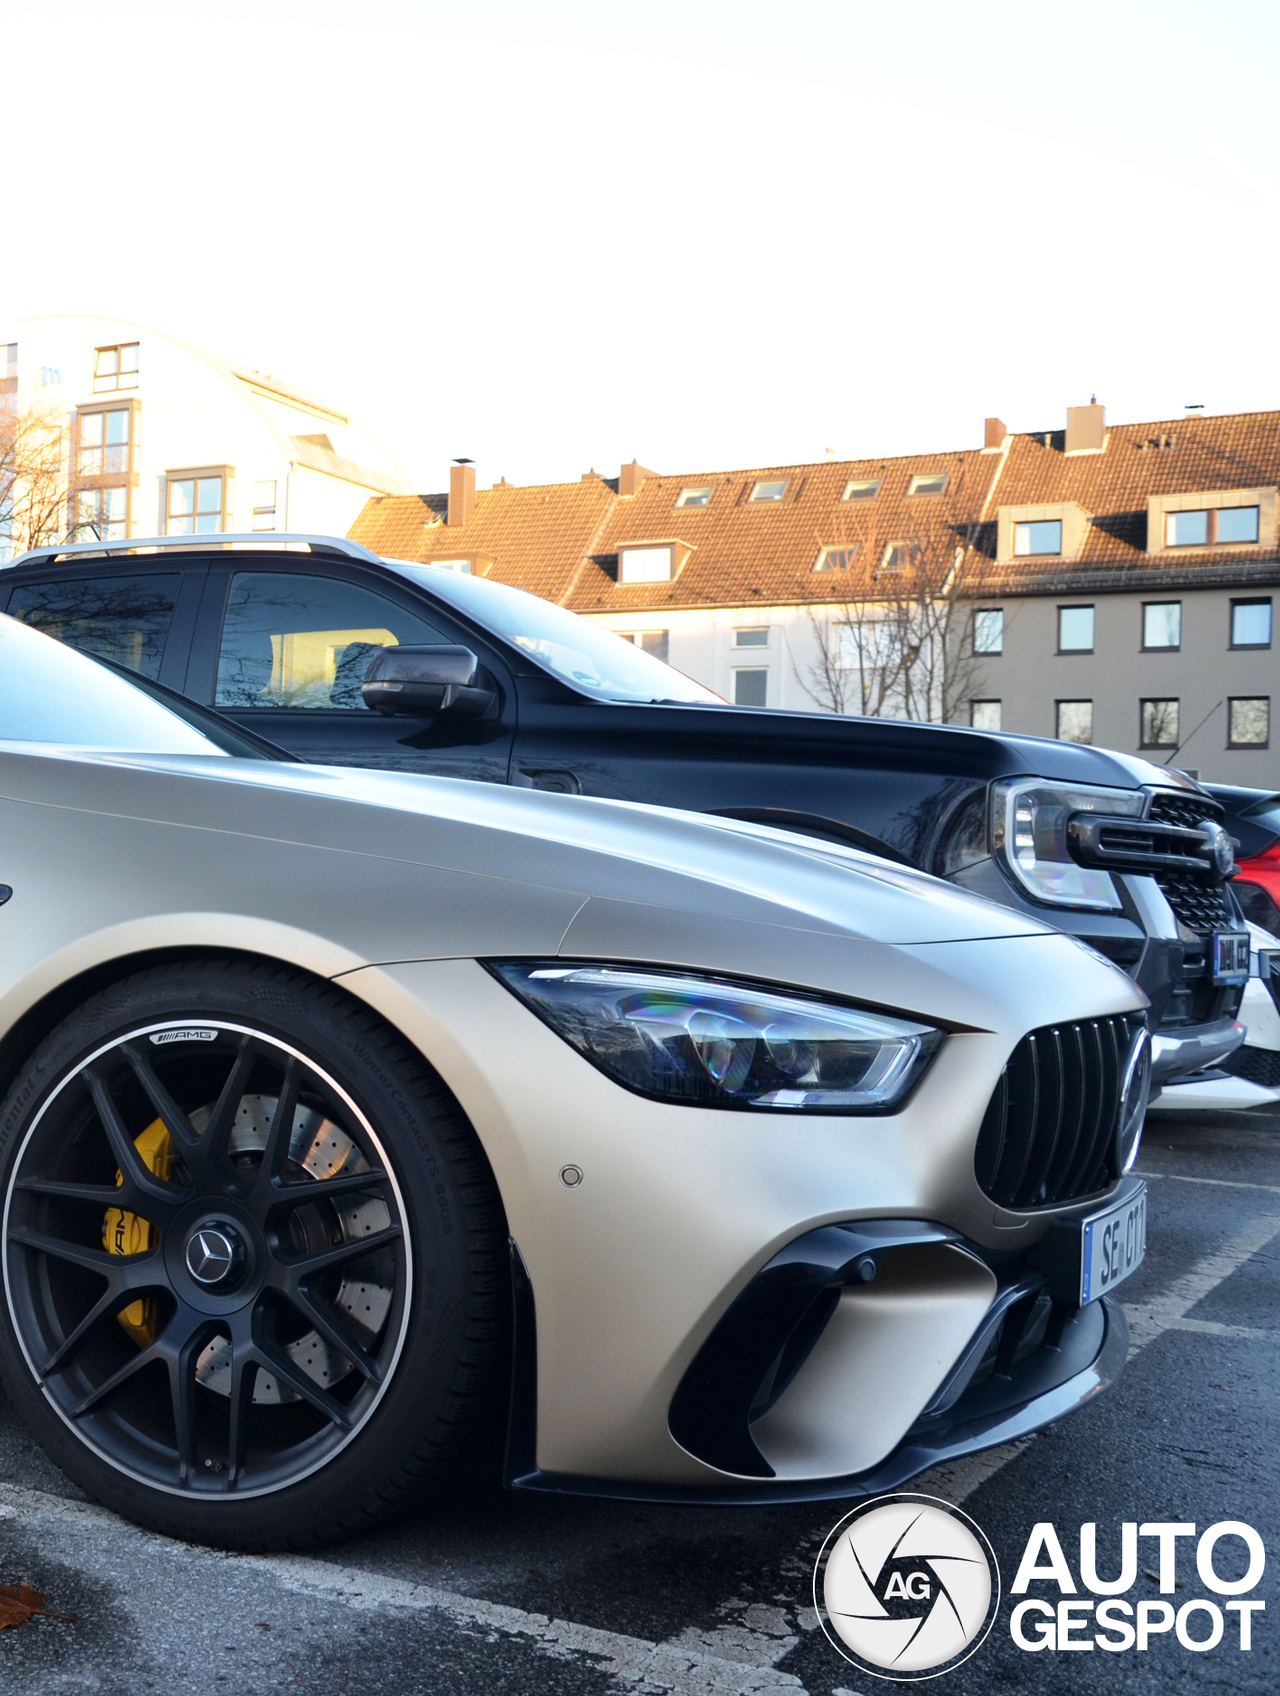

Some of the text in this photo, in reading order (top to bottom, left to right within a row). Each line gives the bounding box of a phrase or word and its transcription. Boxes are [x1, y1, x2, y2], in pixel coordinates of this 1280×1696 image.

[174, 1031, 212, 1039] AMG
[425, 1153, 440, 1178] TS
[1100, 1219, 1120, 1286] SE
